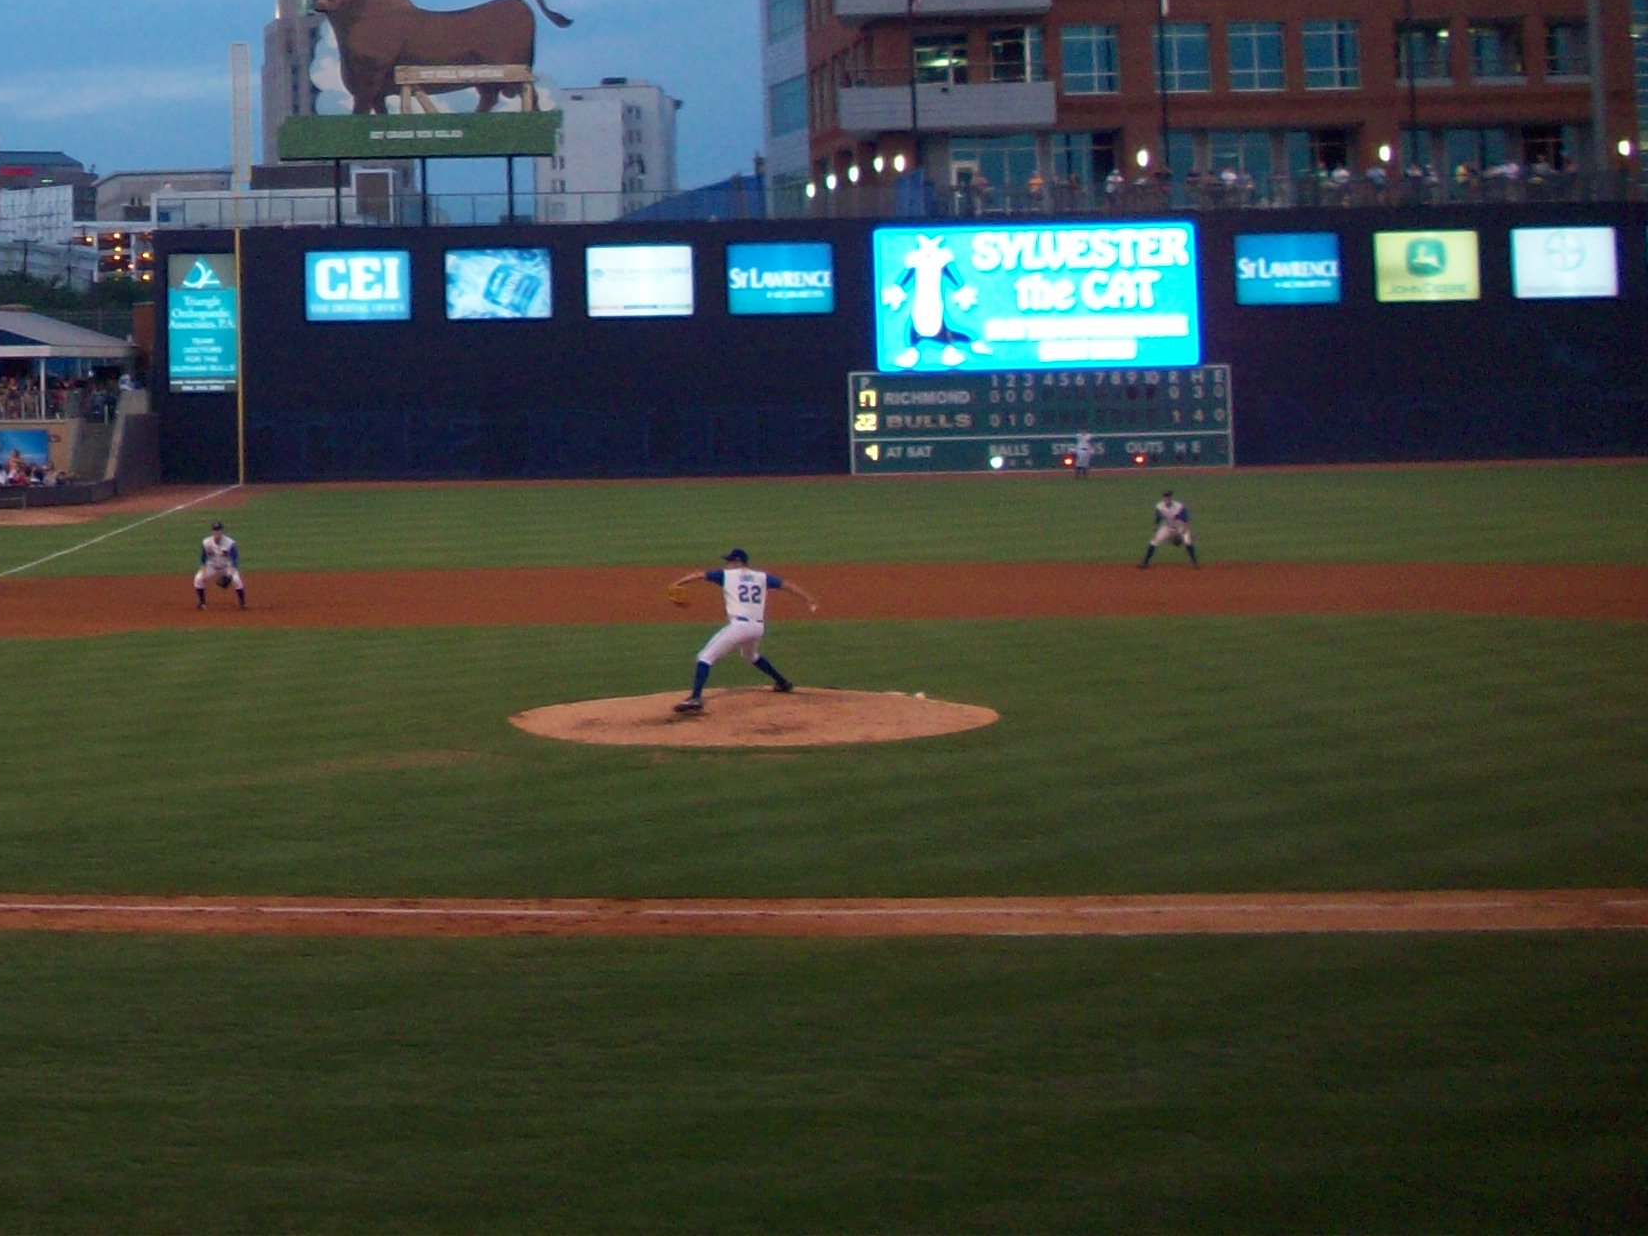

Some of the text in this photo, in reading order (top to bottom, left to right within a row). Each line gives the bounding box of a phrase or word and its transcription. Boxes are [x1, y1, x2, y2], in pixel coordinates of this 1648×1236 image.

[972, 228, 1190, 272] SYLVESTER
[315, 257, 401, 301] CEI
[1014, 271, 1163, 311] the CAT
[992, 375, 999, 387] 1
[1006, 374, 1016, 387] 2
[1024, 374, 1034, 386] 3
[1044, 373, 1054, 386] 4
[1059, 373, 1069, 386] 5
[1076, 373, 1085, 386] 6
[1094, 372, 1104, 385] 7
[1110, 372, 1120, 385] 8
[1168, 371, 1179, 383] R
[1191, 371, 1204, 384] H
[1215, 370, 1224, 383] E
[883, 390, 971, 405] RICHMOND
[1006, 390, 1016, 402] 0
[1024, 389, 1034, 402] 0
[1169, 385, 1180, 399] 0
[1193, 384, 1203, 399] 3
[1214, 384, 1225, 398] 0
[885, 414, 973, 429] BULLS
[1008, 413, 1016, 426] 1
[1024, 413, 1035, 427] 0
[885, 445, 932, 458] AT BAT
[989, 443, 1030, 456] BALLS
[1126, 441, 1164, 454] OUTS
[738, 585, 761, 603] 22
